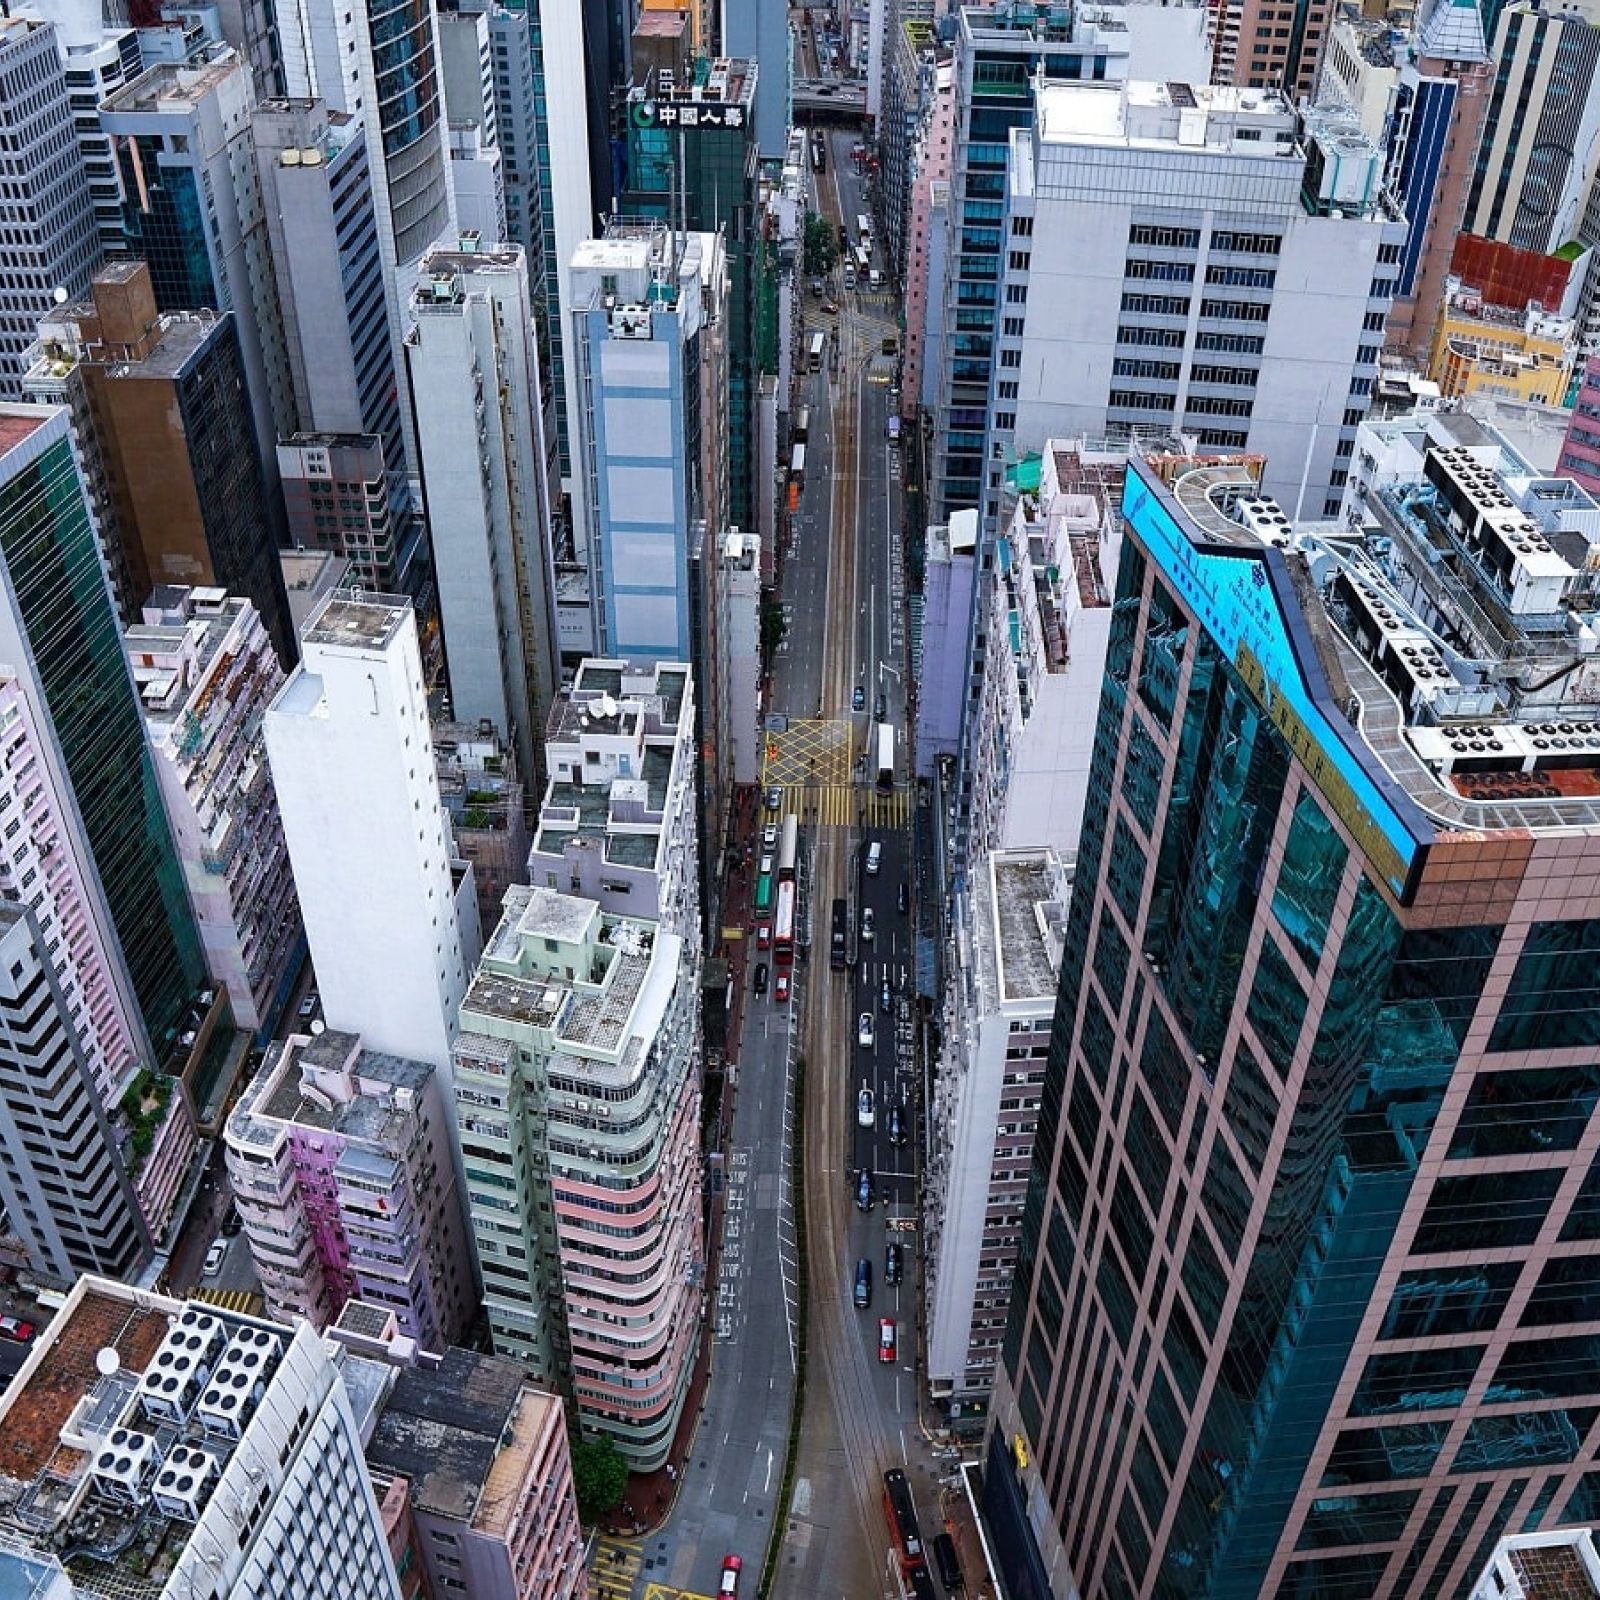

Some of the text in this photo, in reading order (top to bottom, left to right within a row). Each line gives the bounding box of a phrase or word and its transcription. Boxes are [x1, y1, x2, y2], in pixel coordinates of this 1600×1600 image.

[659, 106, 743, 127] 中國人壽
[731, 1153, 748, 1165] BUS
[728, 1171, 748, 1184] STOP
[723, 1243, 740, 1258] BUS
[719, 1263, 739, 1277] STOP
